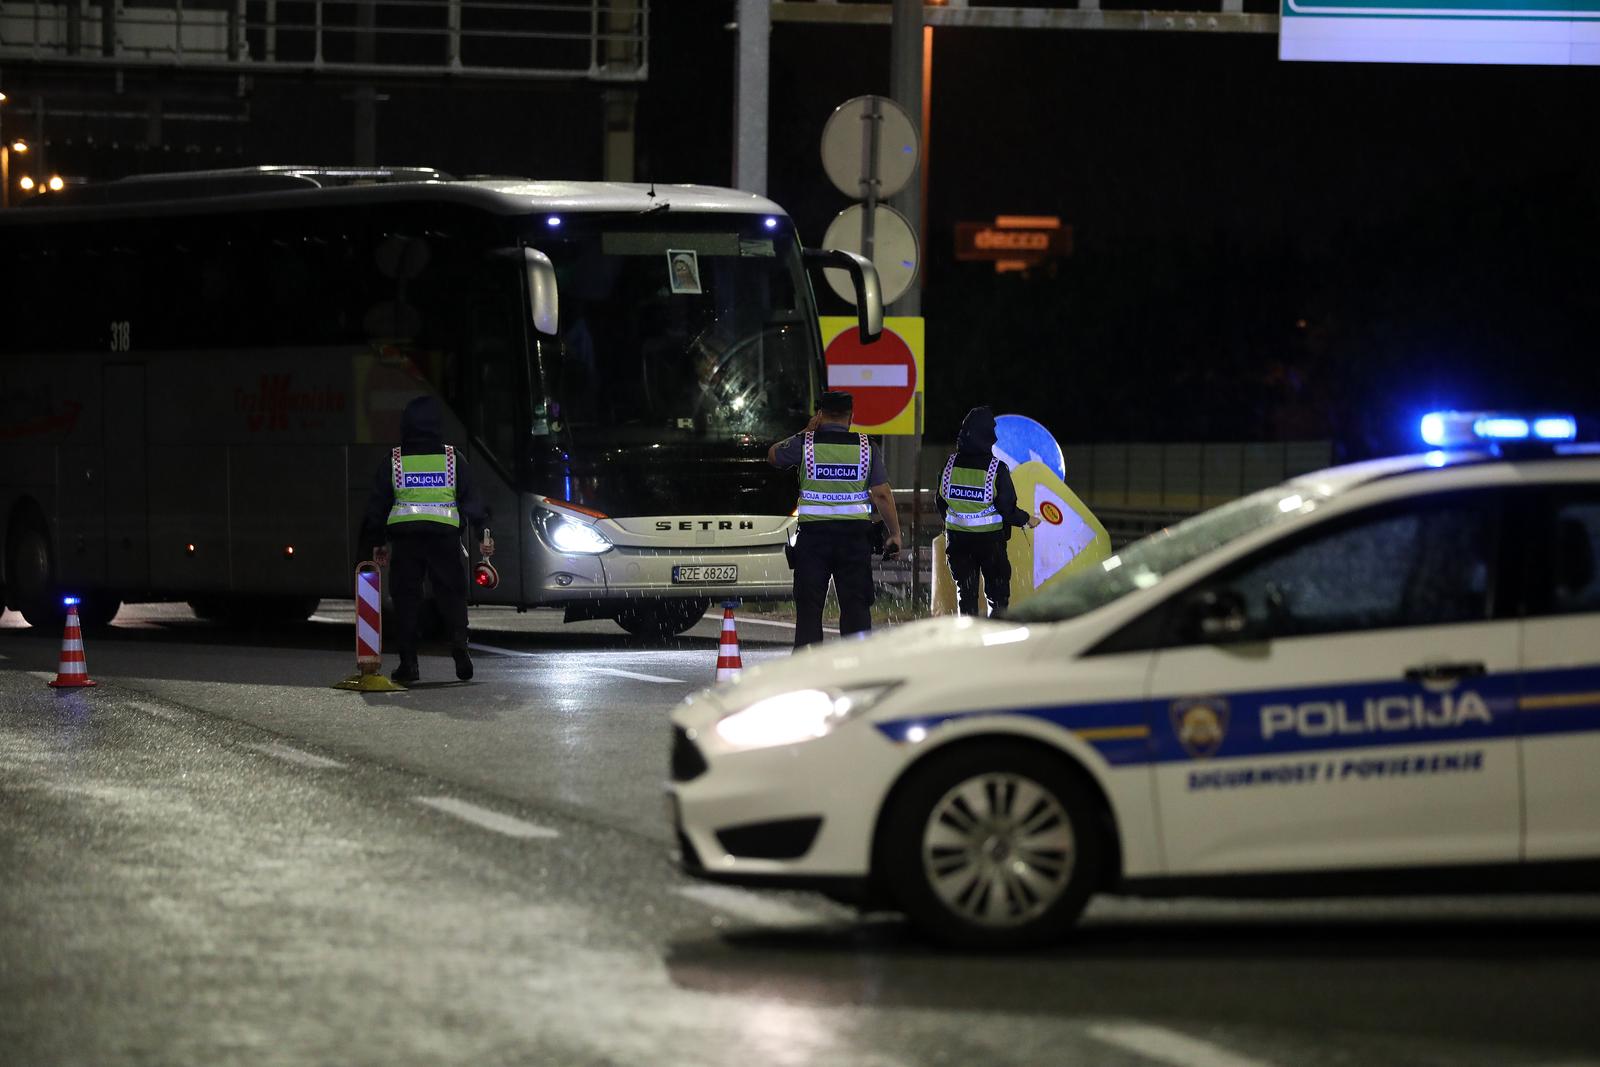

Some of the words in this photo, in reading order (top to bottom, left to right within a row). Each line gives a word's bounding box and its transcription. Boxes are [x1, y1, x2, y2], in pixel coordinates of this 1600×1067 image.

[110, 320, 130, 352] 318
[816, 467, 857, 477] POLICIJA
[406, 475, 444, 484] POLICIJA
[950, 488, 983, 499] POLICIJA
[655, 521, 753, 531] SETRA
[680, 567, 700, 580] RZE
[703, 567, 736, 580] 68262
[1259, 689, 1493, 741] POLICIJA
